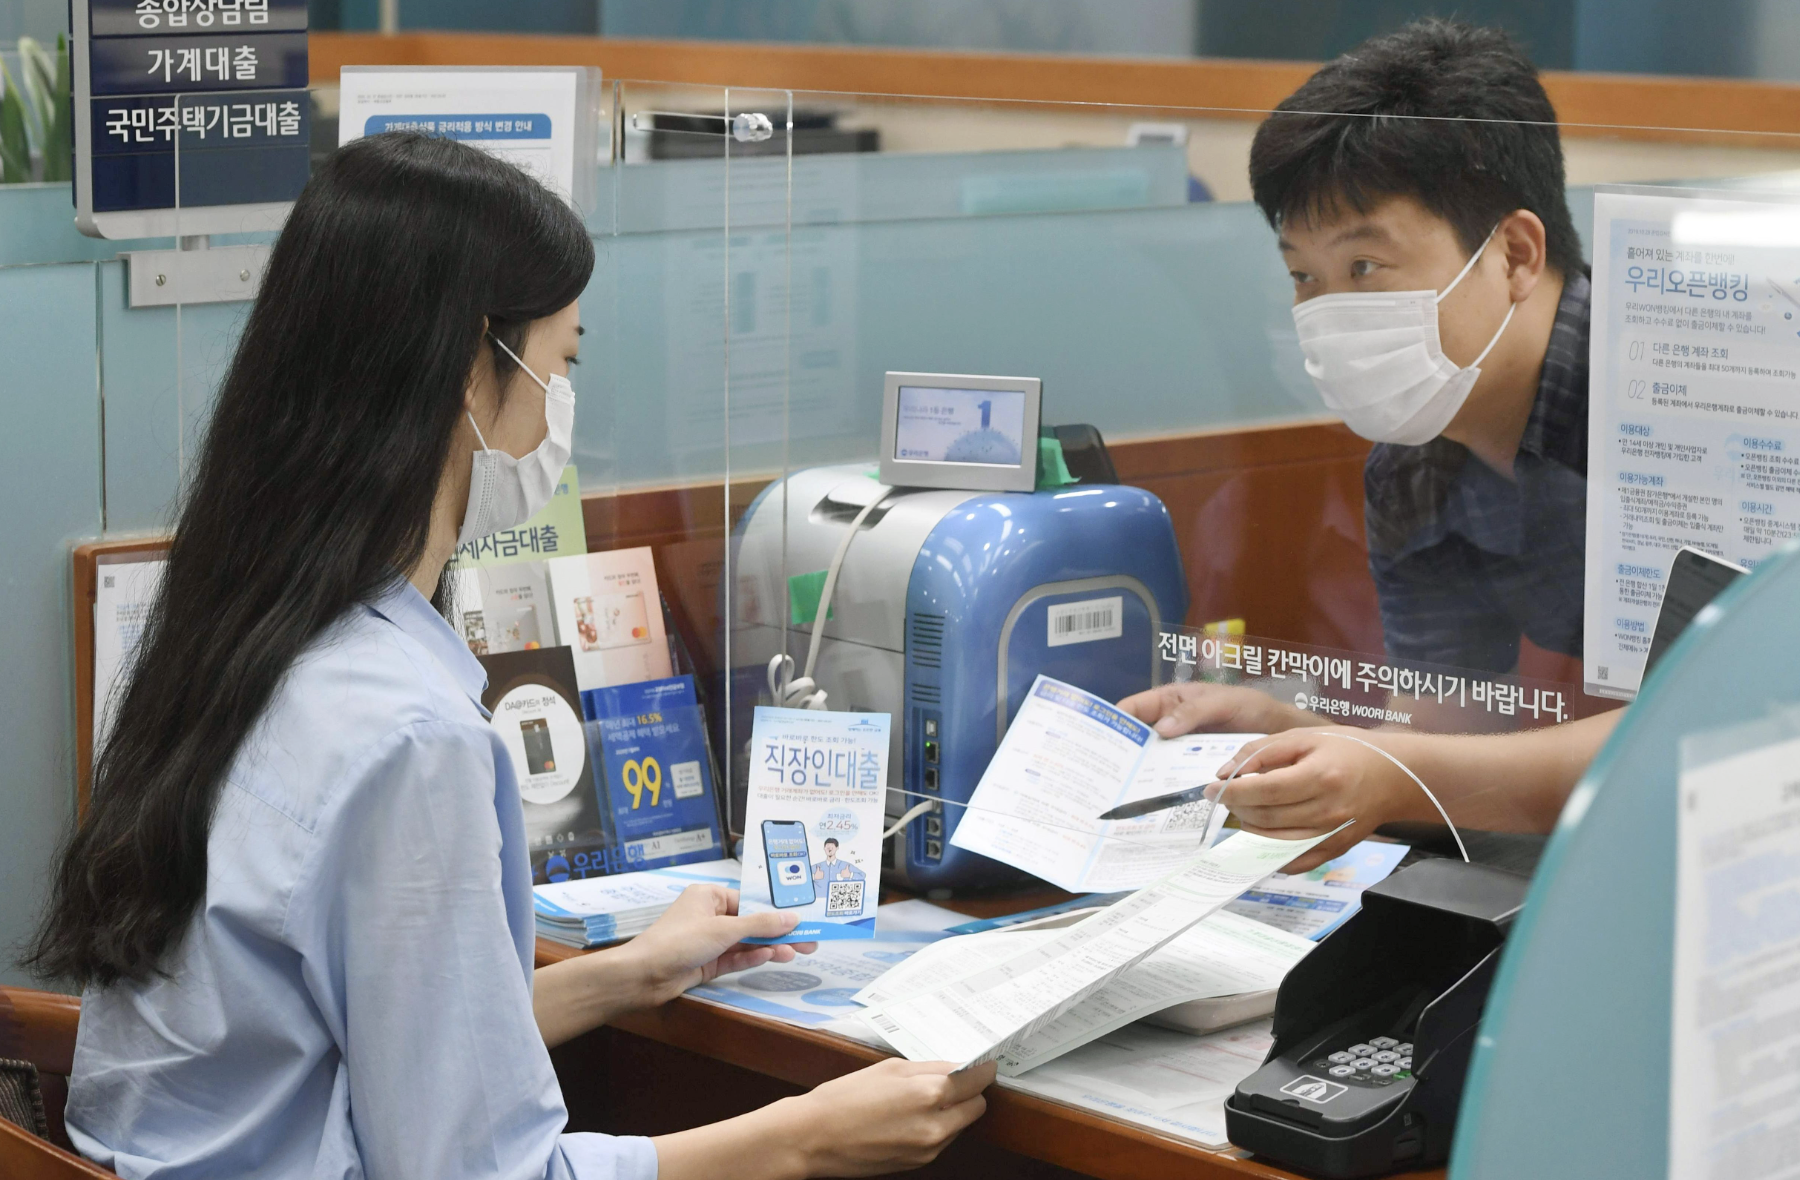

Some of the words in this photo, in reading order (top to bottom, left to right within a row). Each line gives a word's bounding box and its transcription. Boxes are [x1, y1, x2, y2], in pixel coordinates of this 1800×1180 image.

[148, 45, 258, 82] 가계대출
[106, 101, 301, 143] 국민주택기금대출
[475, 121, 492, 132] 방식
[495, 121, 512, 132] 변경
[515, 120, 532, 131] 안내
[1627, 246, 1653, 260] 흩어져
[1656, 248, 1673, 262] 있는
[1676, 250, 1702, 264] 계좌를
[1705, 252, 1735, 265] 한번에!
[1625, 266, 1748, 302] 우리오픈뱅킹
[1625, 302, 1683, 316] 우리WON뱅킹에서
[1685, 306, 1698, 317] 다른
[1700, 307, 1721, 318] 은행의
[1722, 310, 1730, 319] 내
[1732, 310, 1752, 321] 계좌를
[1625, 315, 1651, 326] 조회하고
[1654, 317, 1673, 328] 수수료
[1676, 318, 1689, 329] 없이
[1691, 320, 1725, 333] 출금이체할
[1728, 322, 1734, 332] 수
[1736, 324, 1766, 335] 있습니다!
[1629, 340, 1645, 361] 01
[1653, 342, 1670, 355] 다른
[1673, 344, 1690, 357] 은행
[1692, 346, 1709, 358] 계좌
[1711, 348, 1729, 360] 조회
[1652, 358, 1664, 367] 다른
[1666, 360, 1683, 369] 은행의
[1708, 364, 1720, 372] 최대
[1722, 364, 1747, 375] 50개까지
[1748, 367, 1772, 377] 등록하여
[1773, 369, 1797, 380] 조회가능
[1628, 379, 1646, 400] 02
[1652, 382, 1687, 397] 출금이체
[978, 400, 992, 428] 1
[1652, 398, 1669, 408] 등록된
[1670, 399, 1693, 410] 계좌에서
[1694, 401, 1735, 414] 우리은행계좌로
[1736, 406, 1766, 417] 출금이체할
[1767, 408, 1773, 417] 수
[1774, 410, 1799, 420] 있습니다.
[1620, 424, 1650, 437] 이용대상
[1630, 439, 1642, 448] 14세
[1643, 440, 1654, 449] 이상
[1655, 442, 1666, 451] 개인
[1674, 444, 1708, 455] 개인사업자로
[1744, 438, 1782, 450] 이용수수료
[1622, 447, 1643, 457] 우리은행
[1691, 454, 1702, 463] 고객
[1746, 452, 1768, 463] 오픈뱅킹
[1769, 455, 1781, 464] 조회
[1782, 456, 1799, 465] 수수료
[1746, 464, 1768, 474] 오픈뱅킹
[1769, 466, 1793, 476] 출금이체
[1620, 472, 1664, 487] 이용가능계좌
[1624, 504, 1634, 512] 최대
[1634, 506, 1657, 515] 50개까지
[1698, 513, 1709, 522] 가능
[1742, 502, 1772, 515] 이용시간
[1623, 522, 1634, 531] 가능
[1744, 517, 1766, 528] 오픈뱅킹
[1768, 520, 1796, 531] 중계시스템
[452, 524, 559, 562] 세자금대출
[1618, 564, 1661, 579] 출금이체한도
[1626, 579, 1636, 589] 은행
[1630, 589, 1652, 599] 출금이체
[1616, 618, 1645, 632] 이용방법
[1618, 632, 1642, 643] WON뱅킹
[1158, 632, 1197, 665] 전면
[1202, 638, 1262, 676] 아크릴
[1267, 648, 1351, 690] 칸막이에
[1356, 662, 1466, 708] 주의하시기
[1472, 679, 1569, 724] 바랍니다.
[542, 696, 556, 707] 정석
[1309, 695, 1350, 717] 우리은행
[1352, 704, 1384, 720] WOORI
[1385, 709, 1413, 725] BANK
[637, 712, 663, 725] 16.5%
[810, 736, 824, 744] 한도
[826, 736, 839, 745] 조회
[841, 737, 857, 745] 가능!
[765, 744, 881, 790] 직장인대출
[622, 756, 662, 810] 99
[827, 813, 852, 821] 최저금리
[804, 928, 822, 936] BANK
